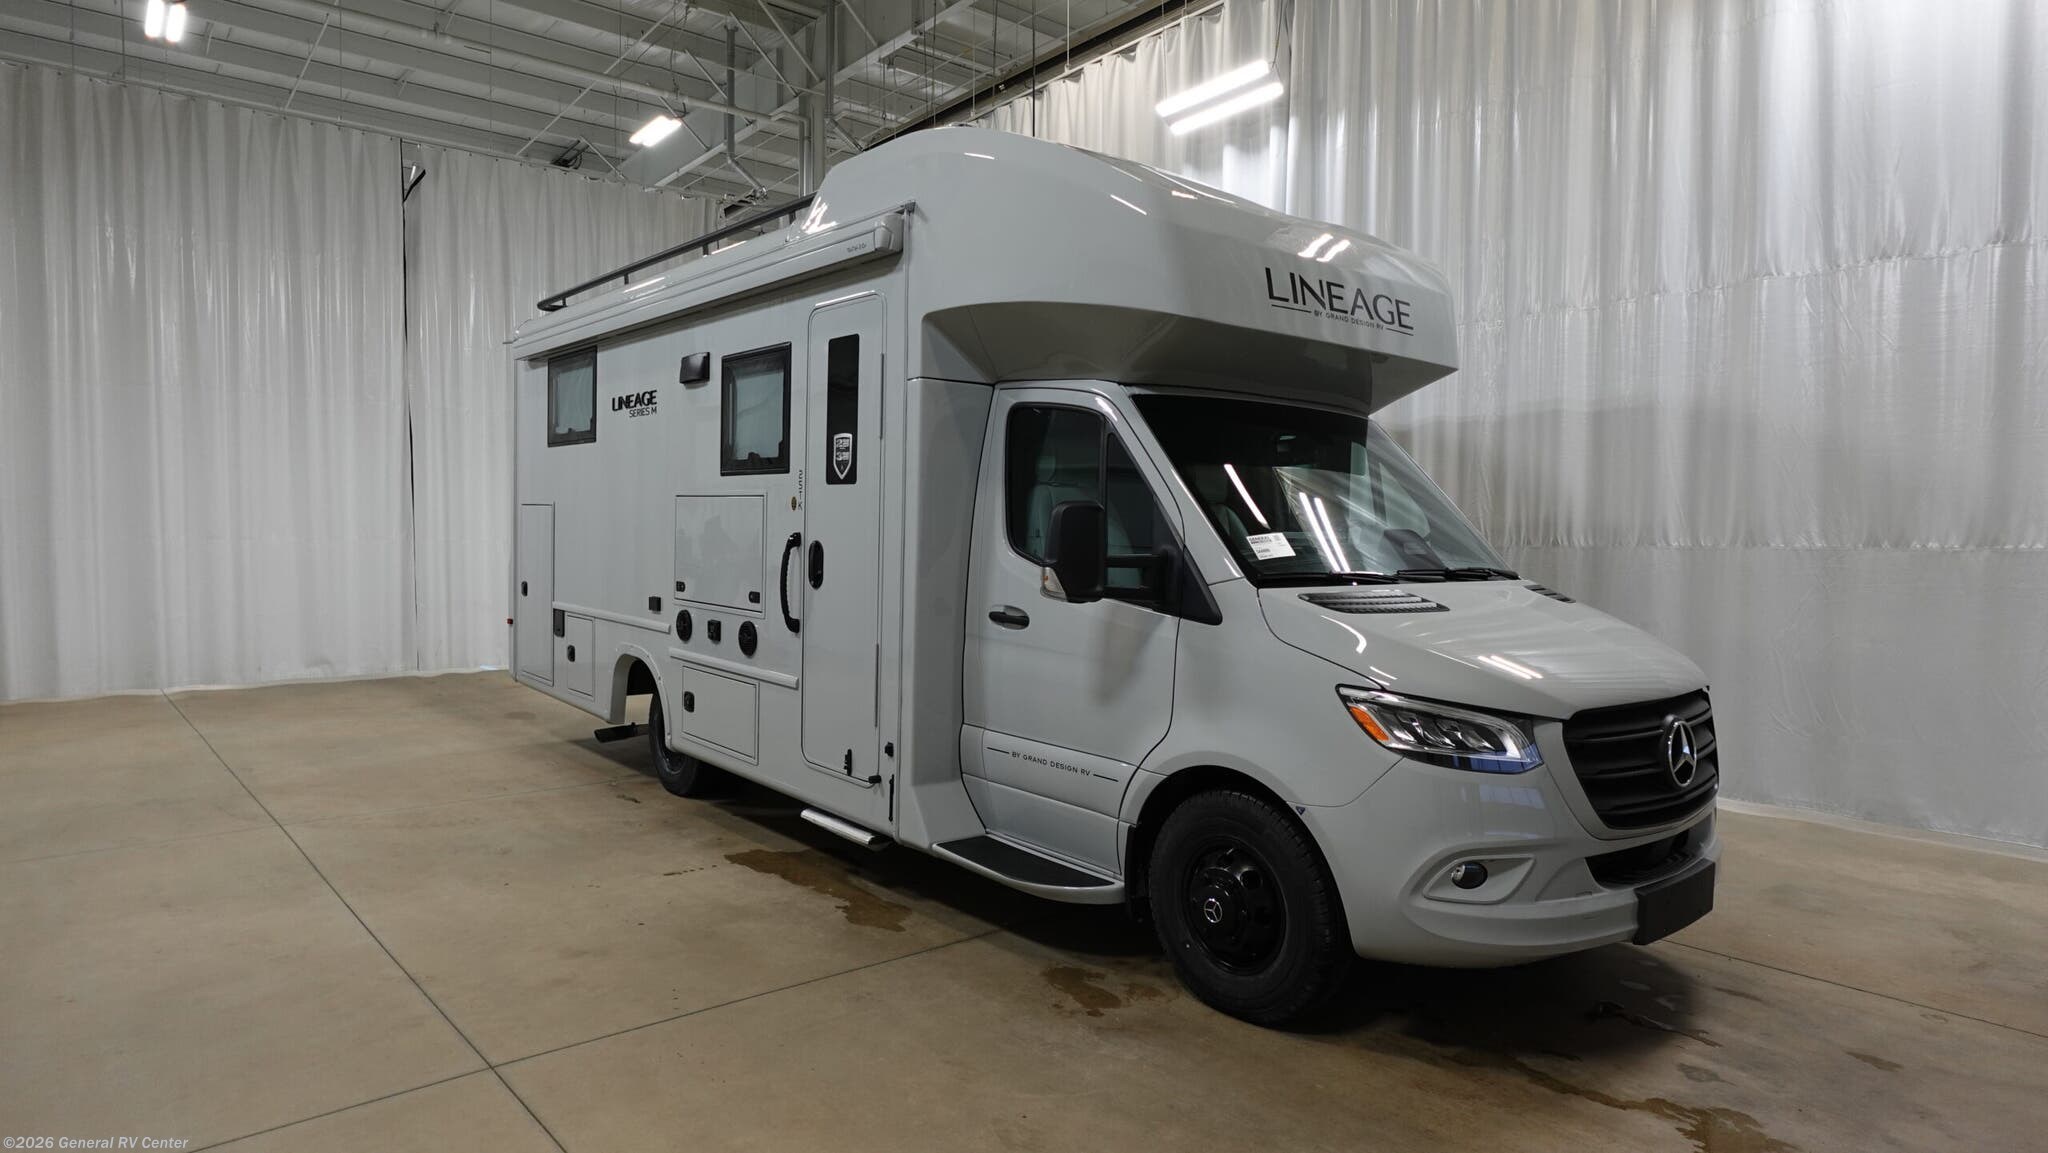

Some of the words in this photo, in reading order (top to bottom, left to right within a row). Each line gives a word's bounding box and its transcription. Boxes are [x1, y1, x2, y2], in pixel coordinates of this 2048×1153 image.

[1265, 267, 1414, 330] LINEAGE
[1326, 312, 1348, 322] GRAND
[1351, 317, 1375, 329] DESIGN
[612, 389, 657, 411] LINEAGE
[629, 407, 651, 418] SERIES
[651, 406, 657, 415] M
[1022, 754, 1047, 765] GRAND
[1050, 761, 1077, 773] DESIGN
[1080, 768, 1090, 776] RV
